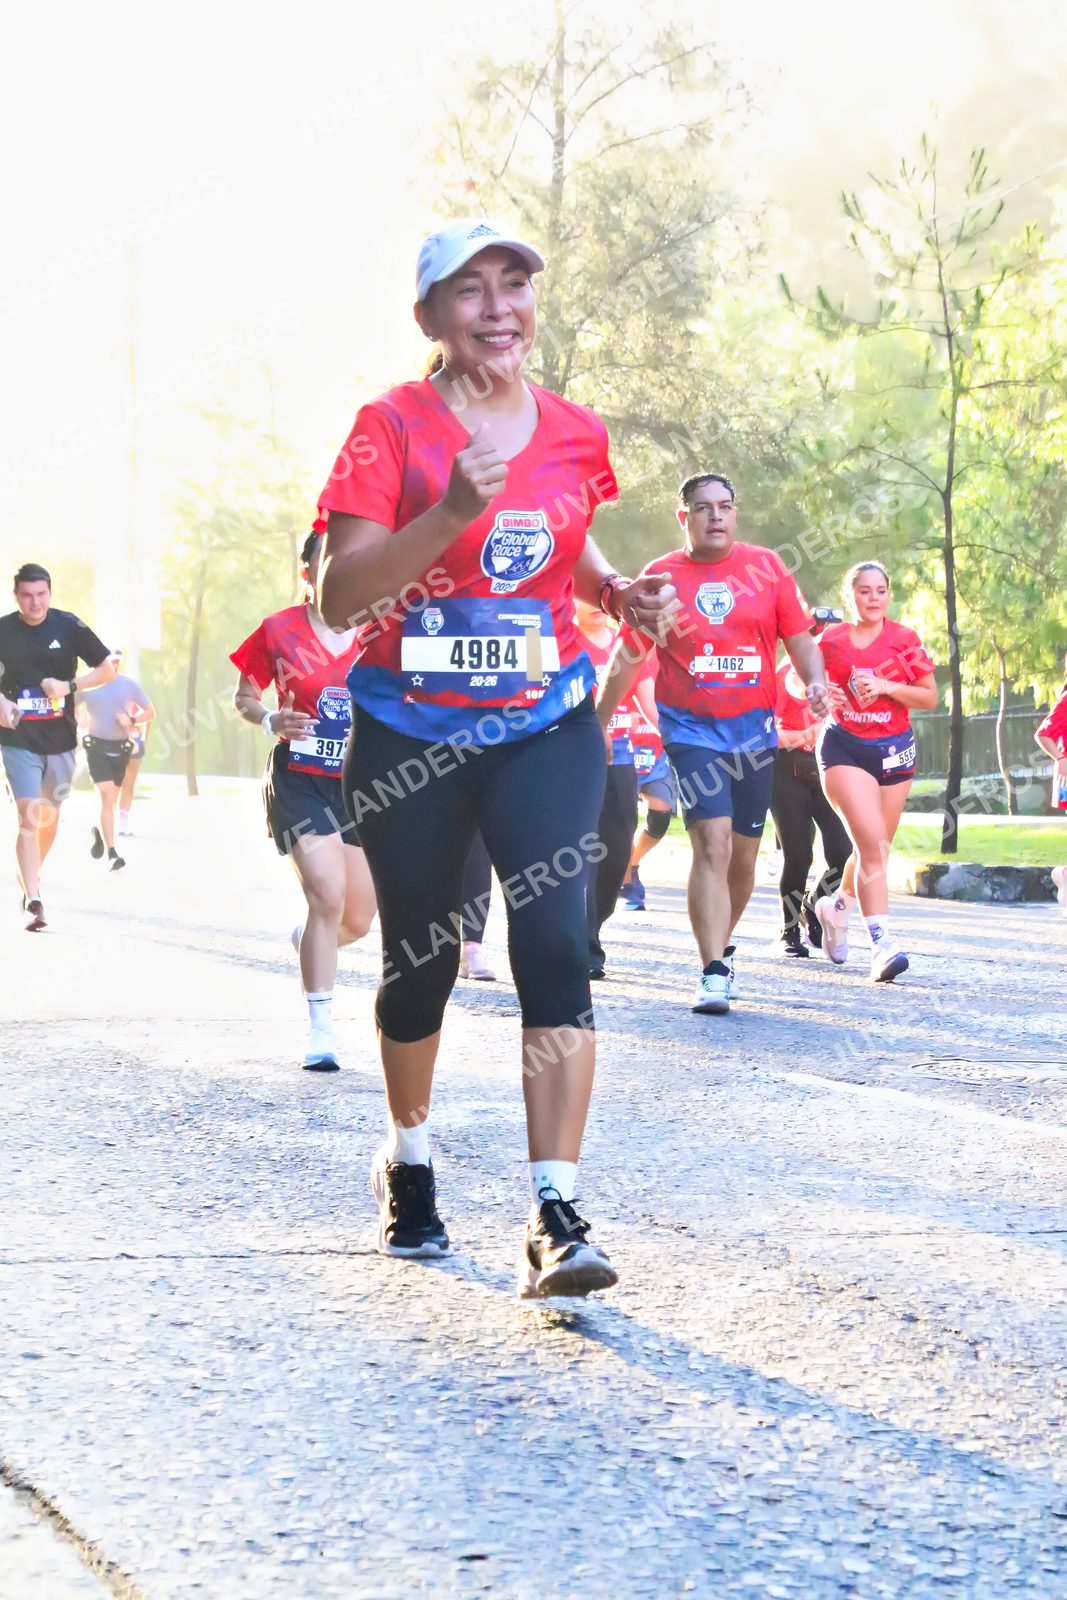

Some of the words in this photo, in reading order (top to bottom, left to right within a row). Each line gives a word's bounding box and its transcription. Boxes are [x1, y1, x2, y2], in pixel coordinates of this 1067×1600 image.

[502, 518, 540, 528] BIMBO
[501, 532, 539, 546] Global
[491, 544, 522, 557] Race
[450, 639, 519, 669] 4984
[717, 657, 744, 671] 1462
[470, 675, 498, 687] 20-26
[842, 711, 891, 723] SANTIAGO
[316, 739, 347, 758] 397
